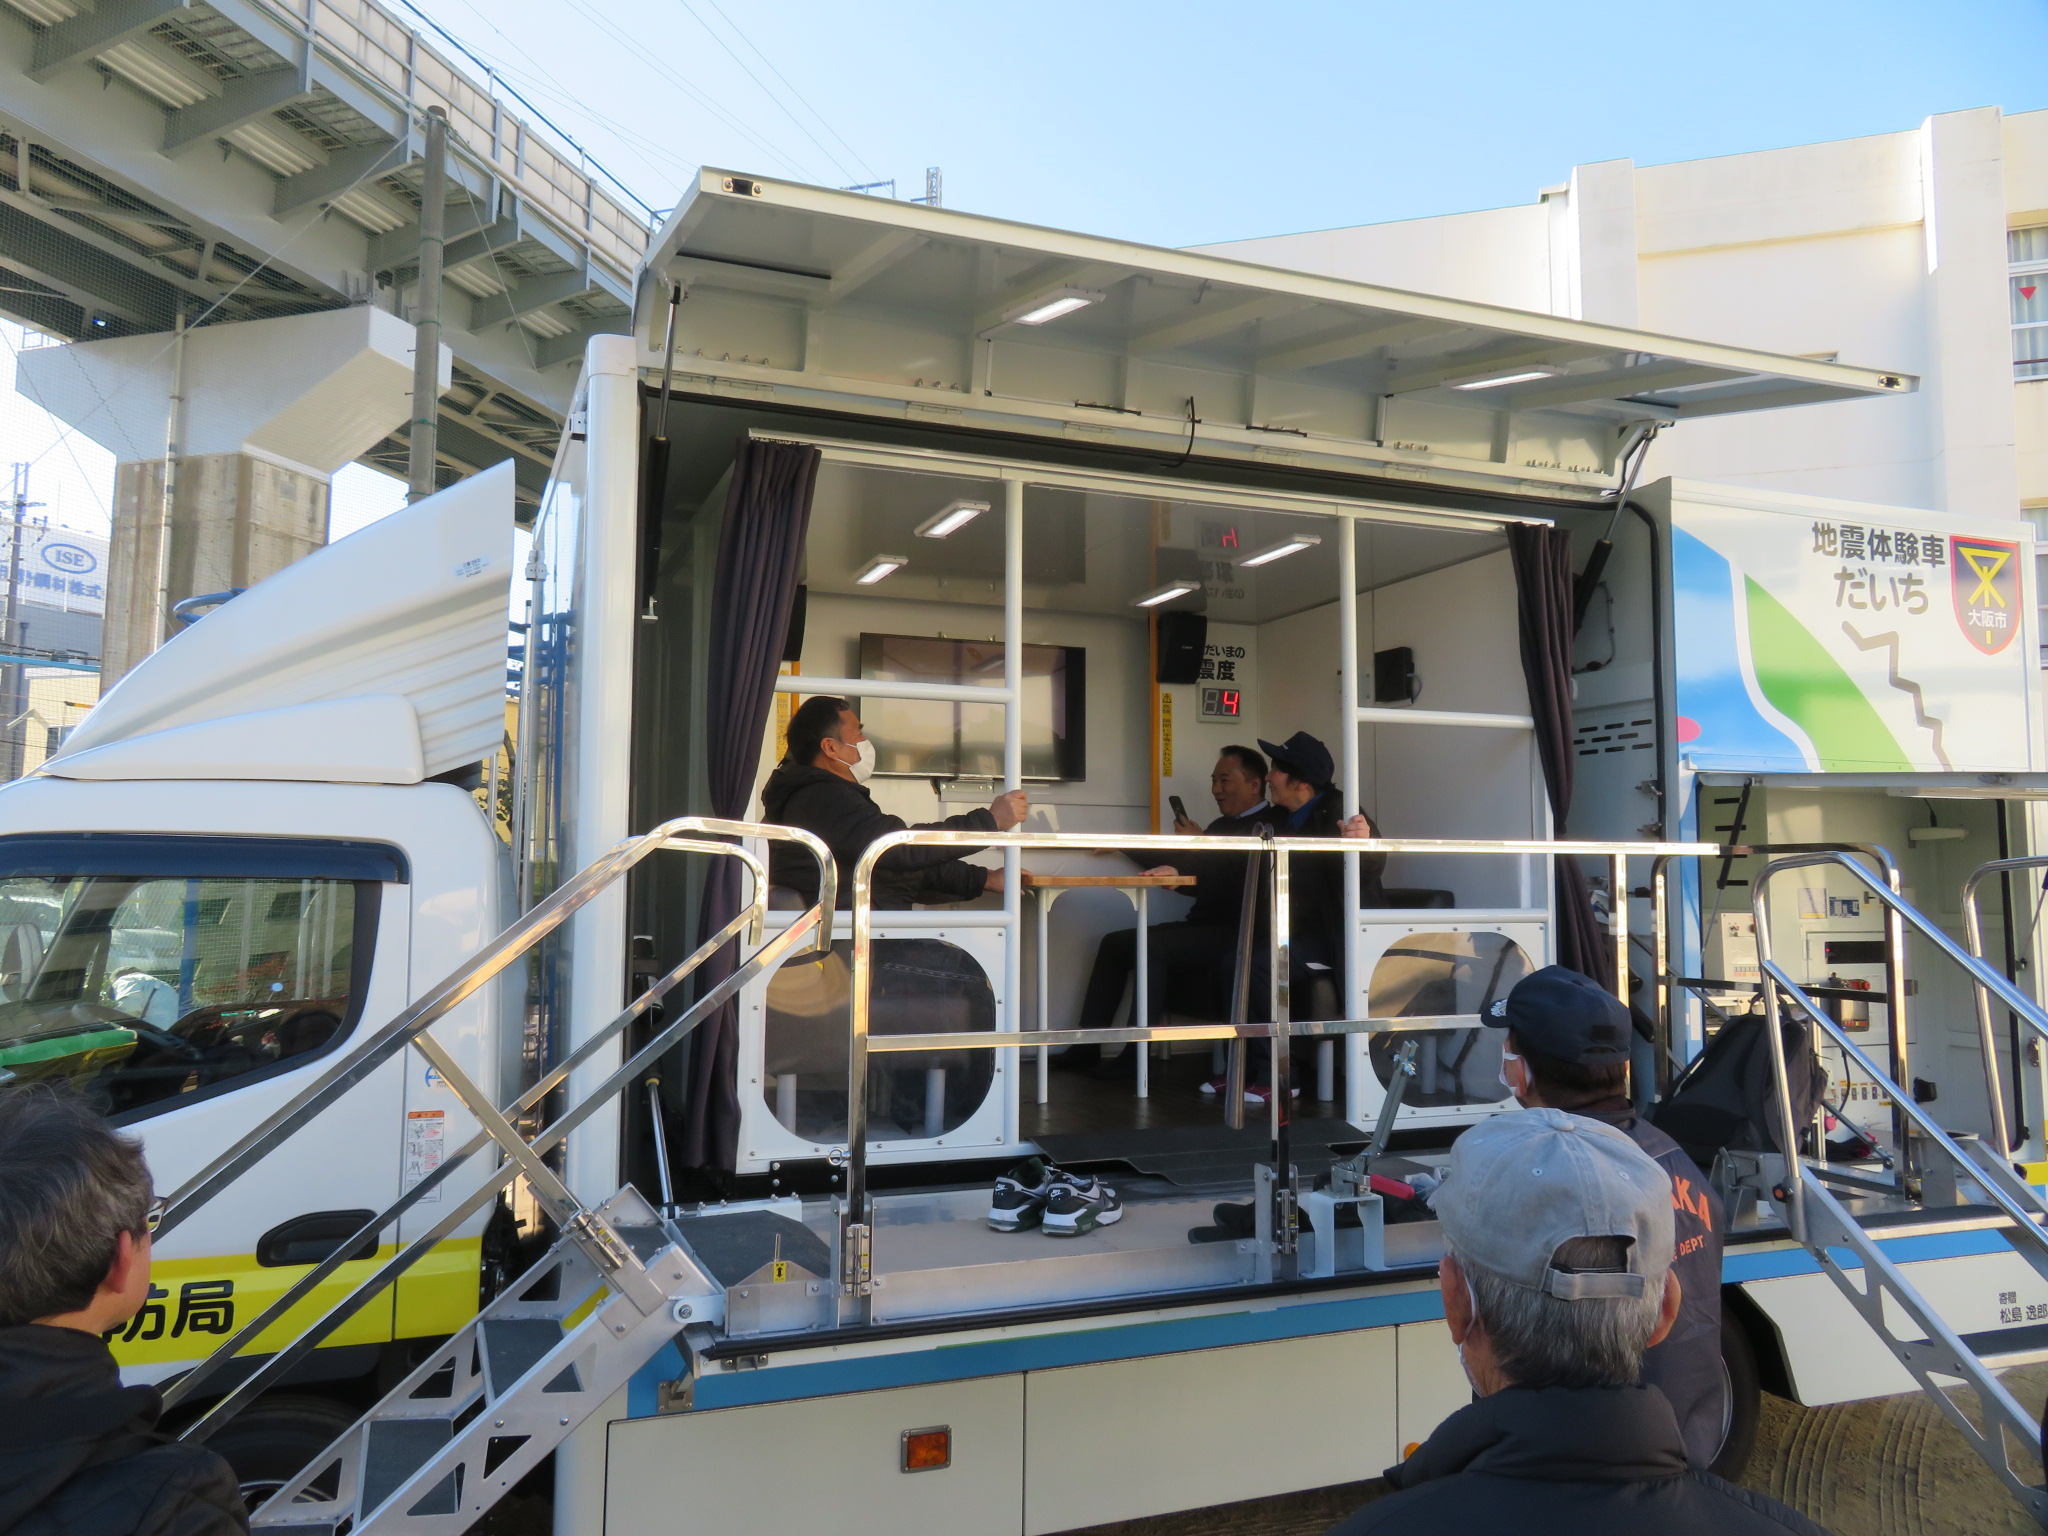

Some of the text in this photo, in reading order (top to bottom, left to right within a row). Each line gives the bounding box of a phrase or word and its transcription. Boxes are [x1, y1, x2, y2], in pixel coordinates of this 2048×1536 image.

[1812, 521, 1946, 568] 地震体験車
[55, 549, 85, 567] ISE
[1833, 565, 1929, 615] だいち
[1968, 608, 2007, 629] 大阪市
[1200, 658, 1236, 681] 震度
[1223, 690, 1240, 716] 4
[1998, 1291, 2017, 1305] 寄贈
